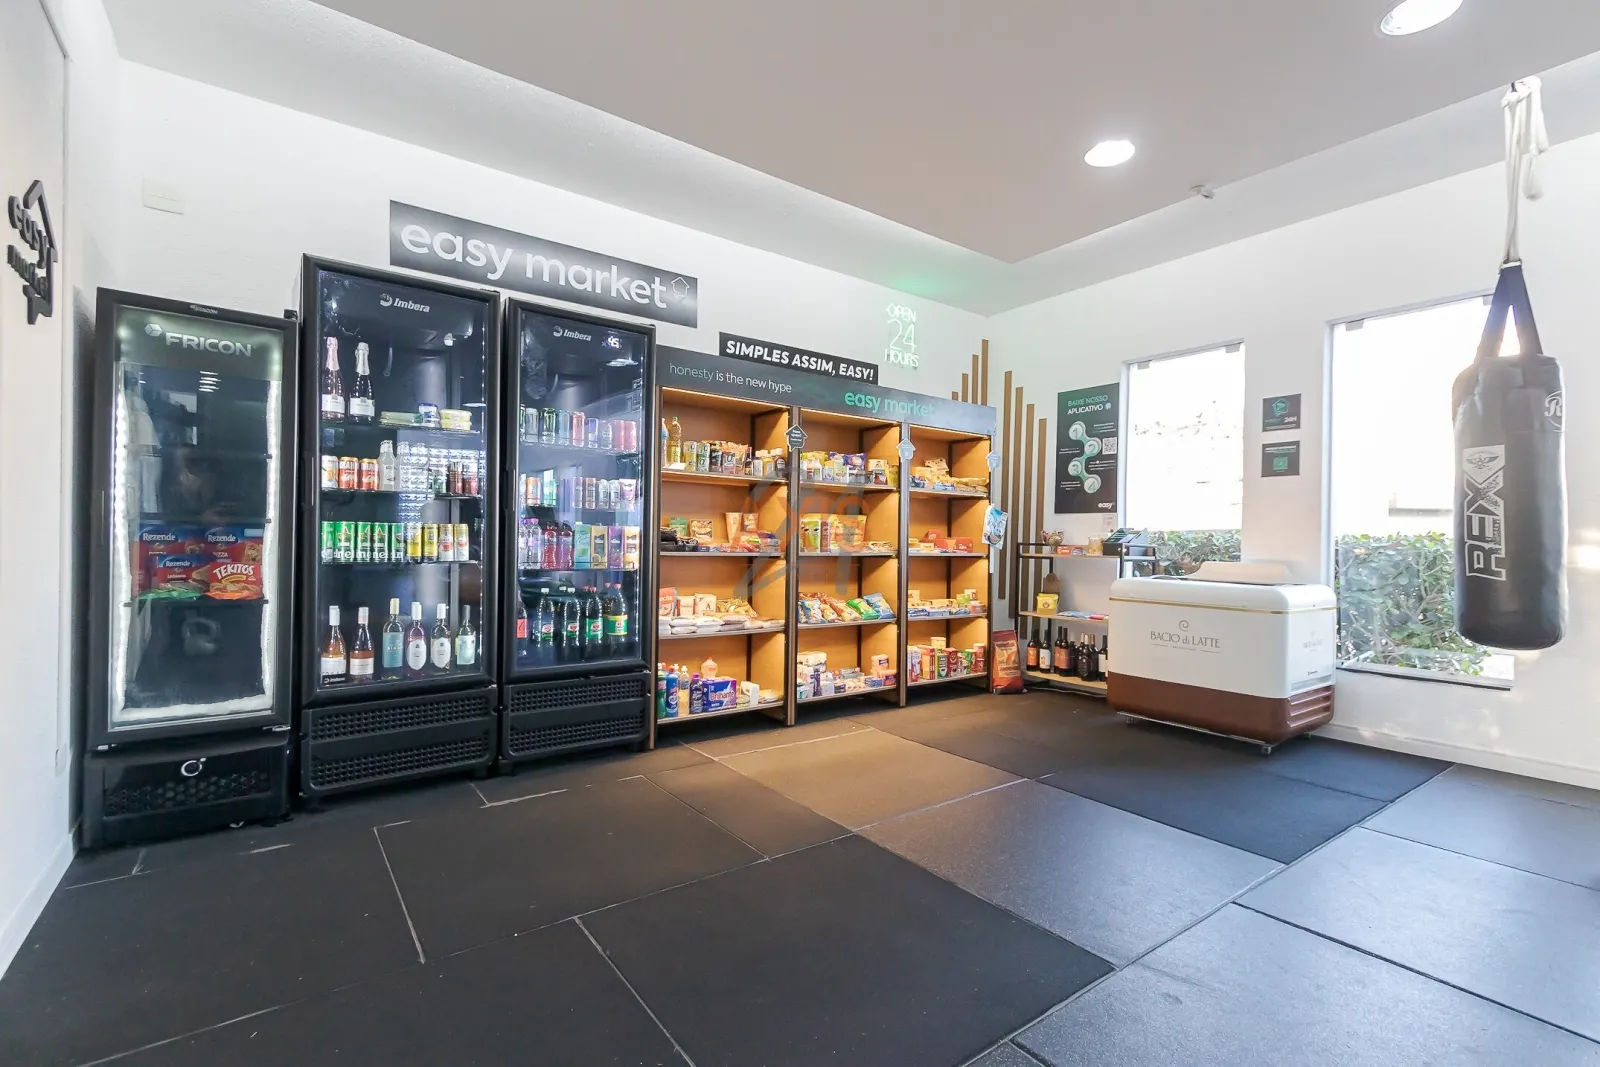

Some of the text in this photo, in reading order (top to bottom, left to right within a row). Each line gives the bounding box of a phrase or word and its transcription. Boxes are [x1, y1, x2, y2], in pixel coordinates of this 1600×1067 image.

[8, 195, 48, 269] easy
[401, 224, 667, 309] easy market
[394, 298, 430, 312] Imbera
[886, 302, 917, 323] OPEN
[165, 332, 252, 357] FRICON
[563, 330, 592, 342] Imbera
[887, 318, 917, 353] 24
[726, 340, 874, 381] SIMPLES ASSIM, EASY!
[884, 348, 919, 367] HOURS
[669, 363, 792, 394] honesty is the new hype
[844, 392, 935, 416] easy market
[1067, 404, 1104, 415] APLICATIVO
[1098, 502, 1113, 510] easy
[143, 532, 176, 541] Rezende
[207, 534, 237, 542] Rezende
[212, 563, 255, 580] TEKITOS
[1150, 631, 1180, 643] BACIO
[1182, 635, 1190, 645] di
[1192, 636, 1221, 649] LATTE
